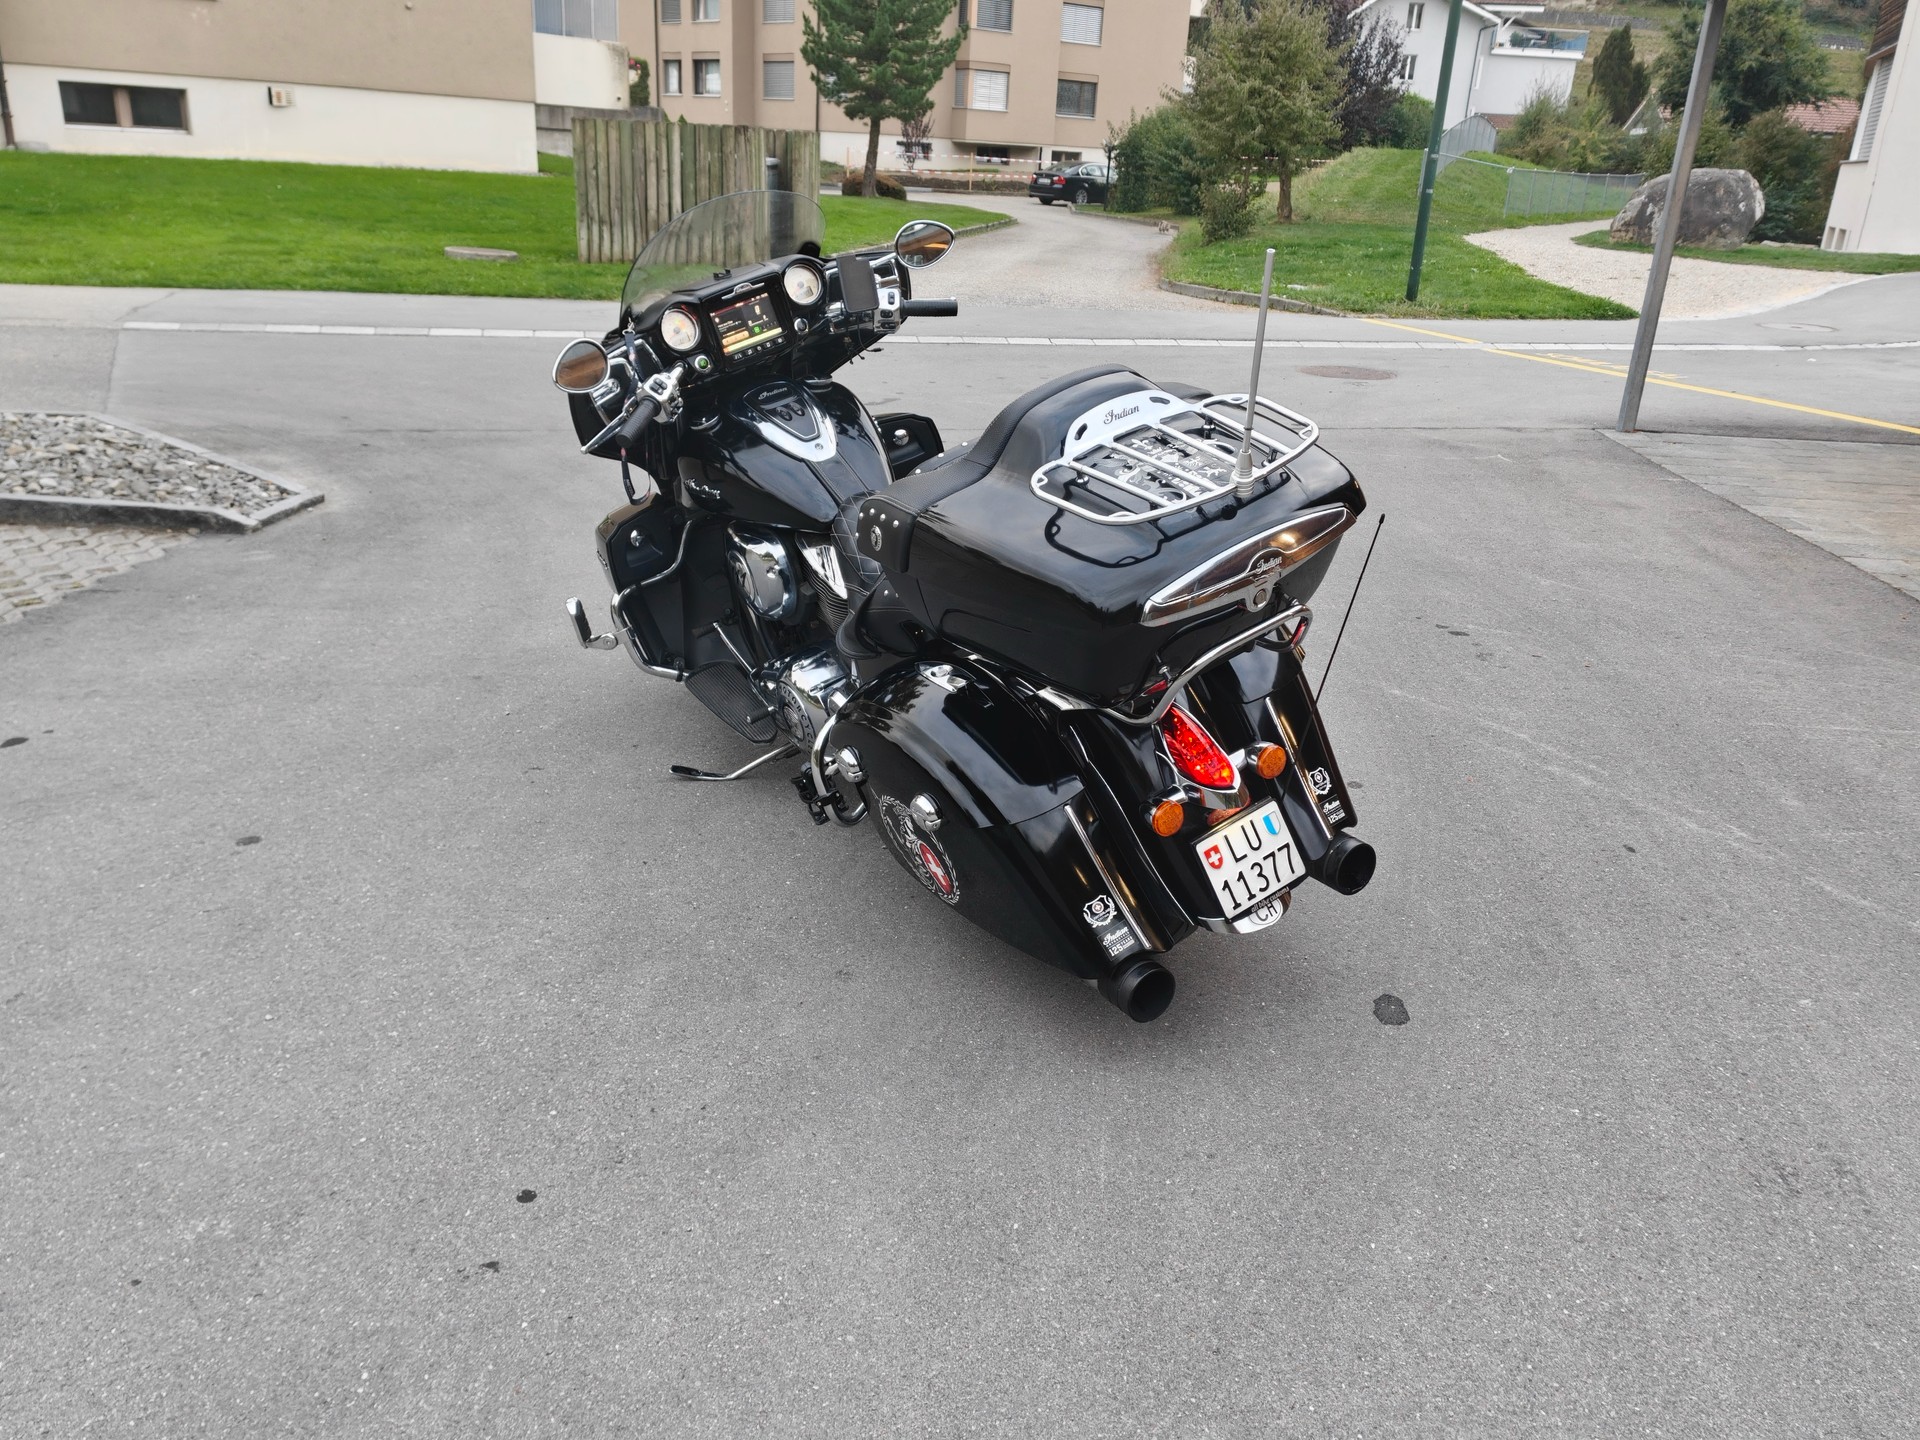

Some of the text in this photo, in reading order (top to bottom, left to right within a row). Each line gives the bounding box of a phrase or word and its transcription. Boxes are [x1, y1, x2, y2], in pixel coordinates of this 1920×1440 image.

[758, 387, 788, 400] Indian
[1103, 405, 1140, 425] Indian
[1255, 556, 1283, 575] Indian
[1223, 819, 1262, 863] LU
[1221, 842, 1295, 911] 11377
[1255, 901, 1278, 922] CH
[1103, 926, 1129, 946] Indian
[1108, 944, 1124, 957] 125
